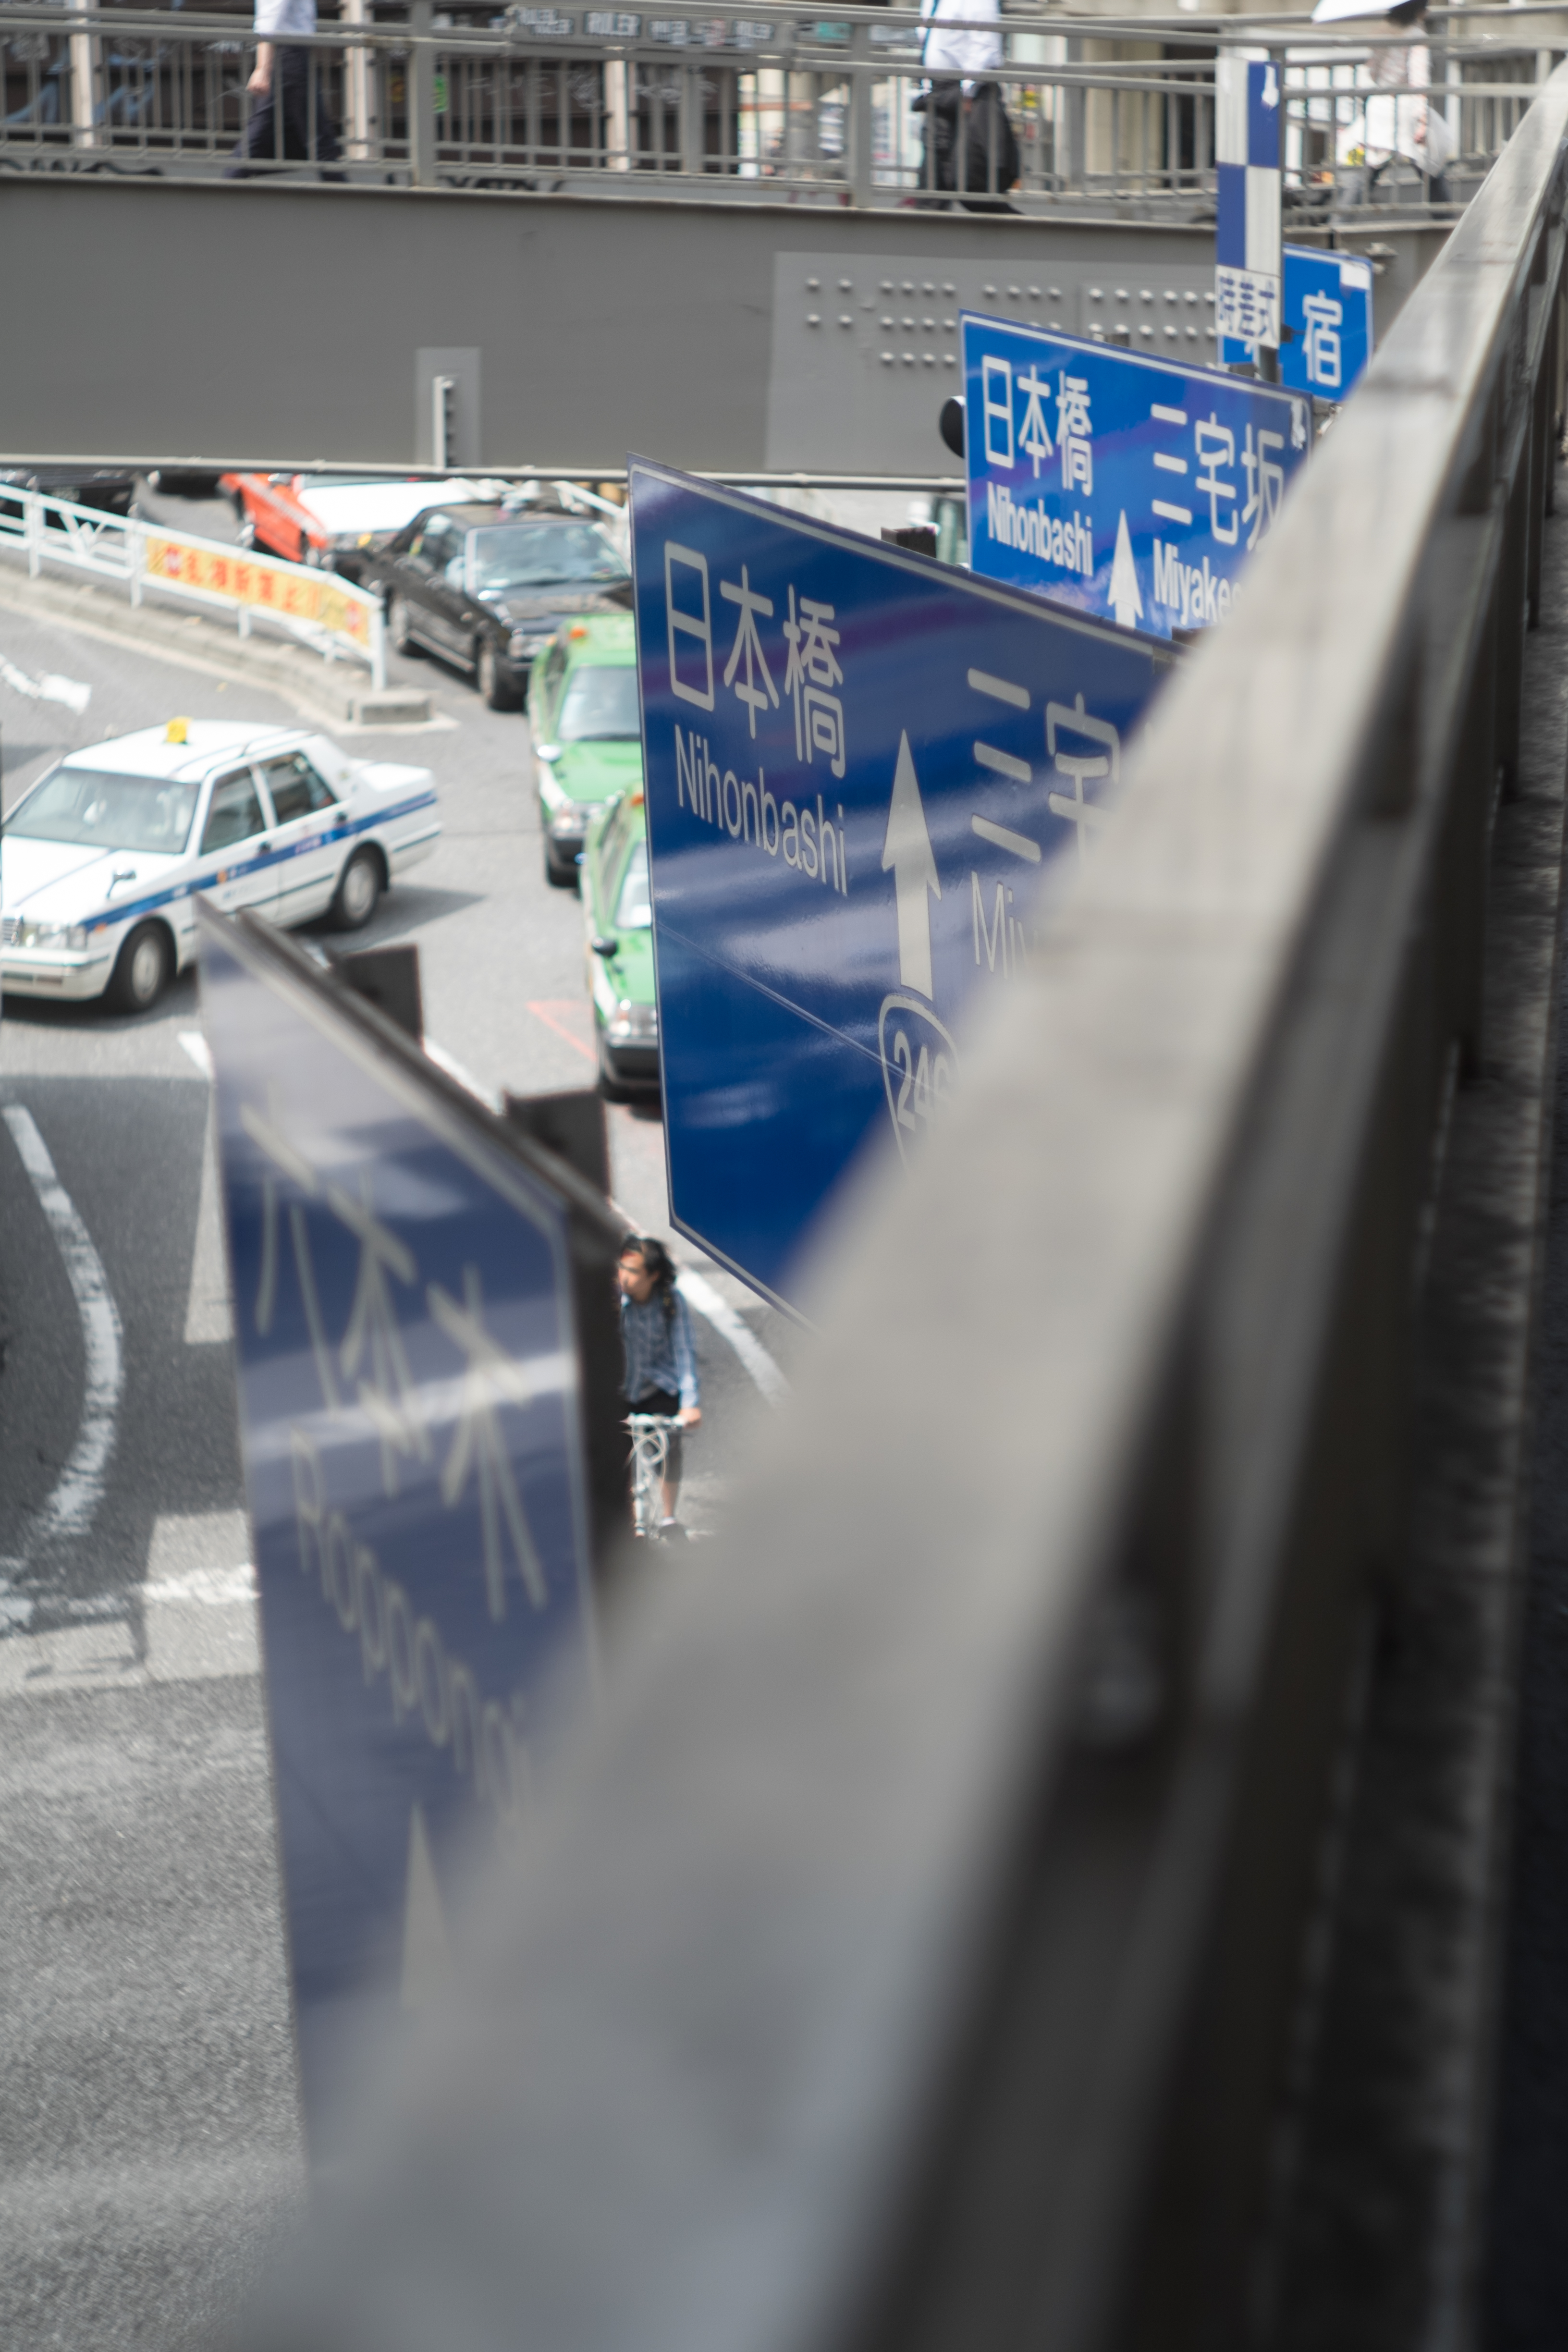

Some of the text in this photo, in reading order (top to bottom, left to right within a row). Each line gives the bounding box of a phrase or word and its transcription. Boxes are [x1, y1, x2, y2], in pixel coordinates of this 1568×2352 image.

[982, 355, 1093, 497] 日本橋
[1151, 403, 1284, 551] 三宅坂
[987, 480, 1093, 576] Nihonbashi
[664, 540, 846, 779] 日本橋
[675, 724, 848, 896] Nihonbashi
[238, 1078, 548, 1623] 六本木
